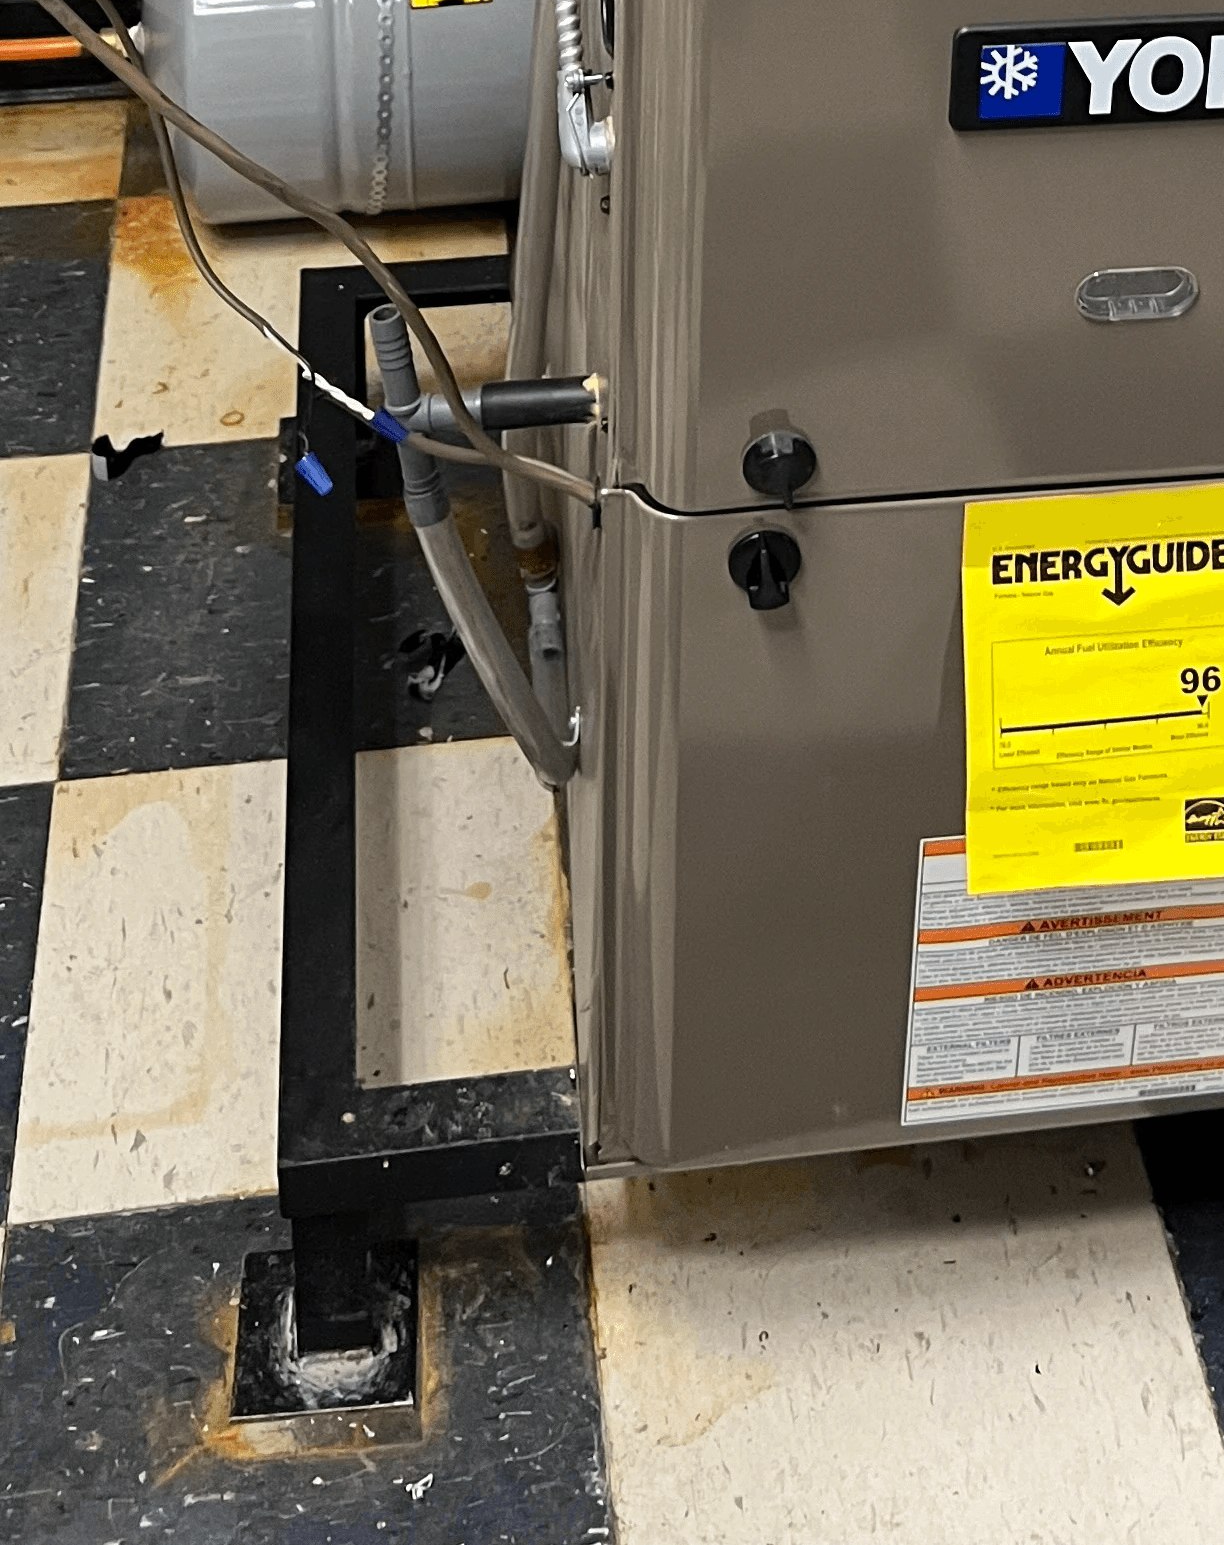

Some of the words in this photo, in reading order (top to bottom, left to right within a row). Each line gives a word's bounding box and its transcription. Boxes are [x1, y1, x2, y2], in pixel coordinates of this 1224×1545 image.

[1180, 666, 1221, 694] 96
[1039, 910, 1164, 932] AVERTISSEMENT
[1043, 968, 1147, 987] ADVERTENCIA
